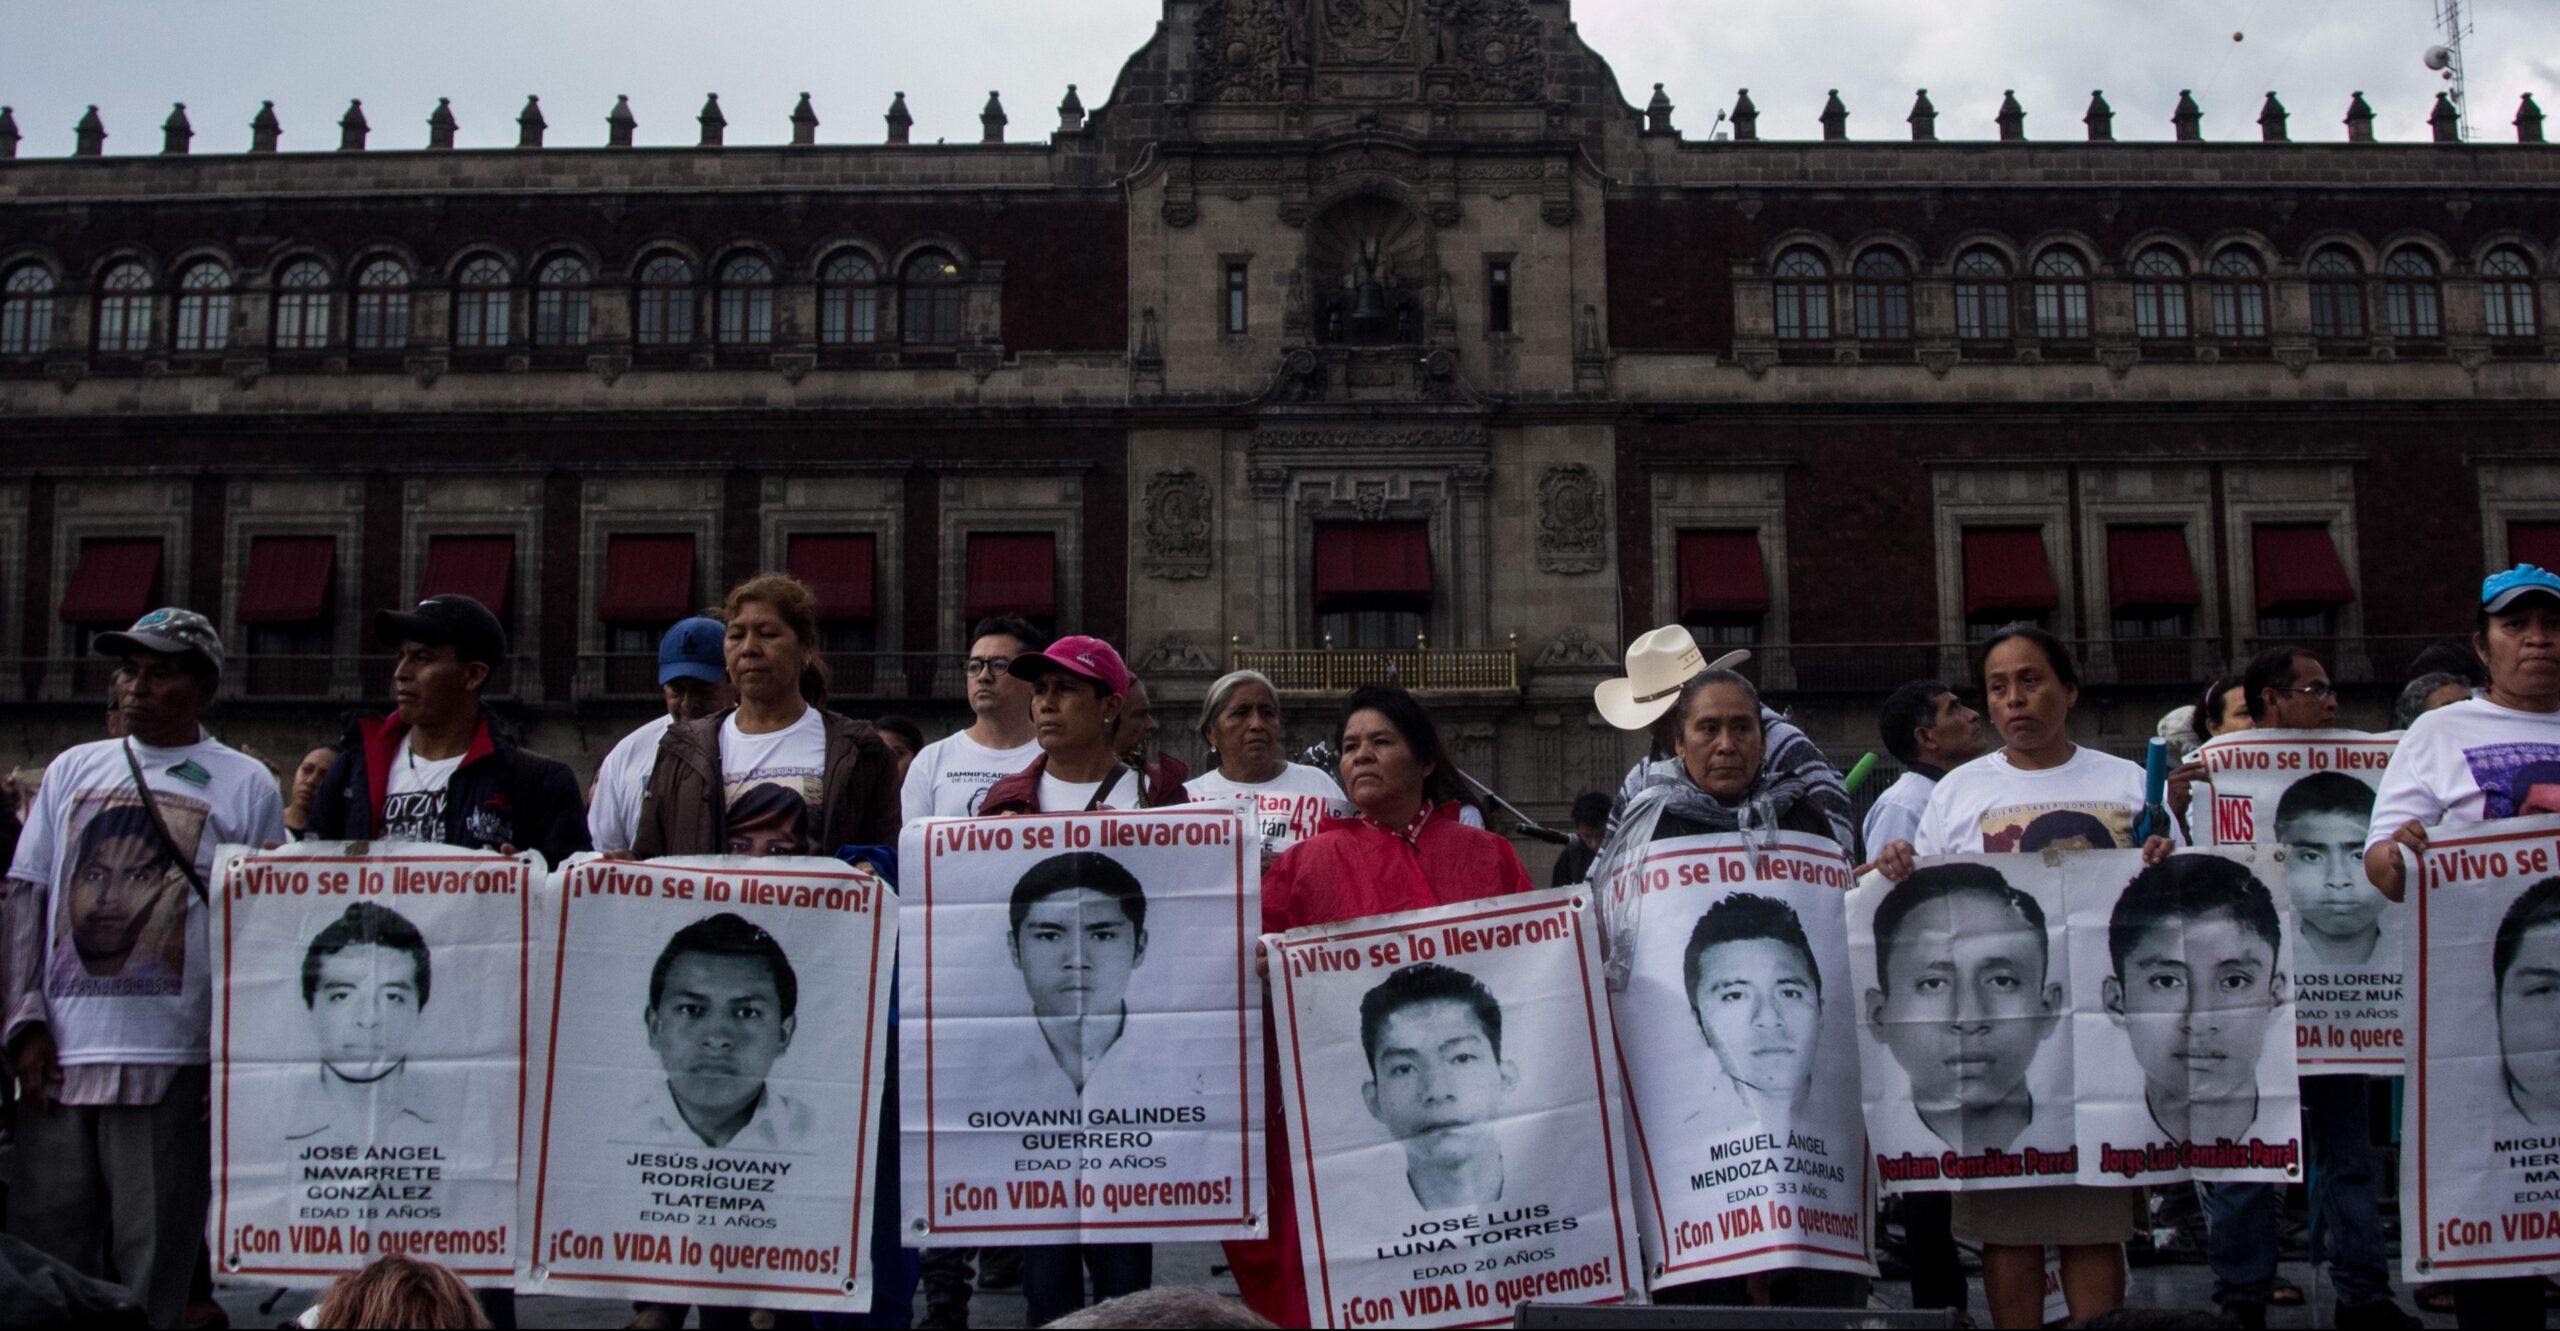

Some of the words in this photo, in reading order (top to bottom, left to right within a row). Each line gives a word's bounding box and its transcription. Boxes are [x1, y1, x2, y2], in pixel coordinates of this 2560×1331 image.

[2211, 747, 2270, 773] ¡Vivo
[2277, 753, 2300, 769] se
[2309, 747, 2328, 770] lo
[2336, 748, 2394, 770] lleva
[1261, 817, 1288, 838] tán
[2219, 799, 2254, 841] NOS
[936, 824, 1013, 857] ¡Vivo
[1023, 825, 1054, 850] se
[1064, 821, 1091, 848] lo
[1101, 819, 1231, 848] llevaron!
[234, 865, 309, 899] ¡Vivo
[317, 871, 349, 895] se
[358, 867, 384, 895] lo
[392, 866, 518, 895] llevaron!
[1678, 863, 1710, 886] se
[1718, 857, 1746, 883] lo
[2429, 849, 2508, 889] ¡Vivo
[2515, 848, 2548, 875] se
[573, 866, 653, 898] ¡Vivo
[661, 877, 695, 900] se
[703, 876, 731, 902] lo
[739, 878, 871, 913] llevaron!
[1292, 945, 1361, 978] ¡Vivo
[1370, 940, 1401, 968] se
[1408, 934, 1437, 962] lo
[1442, 911, 1569, 957] llevaron!
[2295, 988, 2361, 1001] ÁNDEZ
[2335, 1010, 2351, 1019] 19
[2356, 1007, 2399, 1019] AÑOS
[2328, 1024, 2344, 1048] lo
[2350, 1028, 2403, 1051] quere
[968, 1110, 1082, 1128] GIOVANNI
[1088, 1106, 1206, 1125] GALINDES
[300, 1146, 359, 1161] JOSÉ
[1022, 1132, 1153, 1150] GUERRERO
[1710, 1133, 1781, 1162] MIGUEL
[1787, 1130, 1828, 1156] ÁNGEL
[2494, 1136, 2560, 1153] MIGU
[304, 1167, 441, 1180] NAVARRETE
[627, 1153, 699, 1170] JESÚS
[702, 1159, 792, 1175] JOVANY
[1015, 1159, 1071, 1171] EDAD
[1079, 1158, 1102, 1169] 20
[1109, 1155, 1167, 1169] AÑOS
[1691, 1158, 1779, 1191] MENDOZA
[1784, 1157, 1845, 1183] ZACARIAS
[2101, 1142, 2147, 1178] Jorge
[2146, 1141, 2180, 1171] Luis
[307, 1185, 433, 1200] GONZÁLEZ
[641, 1173, 775, 1192] RODRÍGUEZ
[945, 1182, 998, 1216] ¡Con
[1006, 1180, 1068, 1209] VIDA
[1075, 1177, 1095, 1208] lo
[1103, 1176, 1232, 1213] queremos!
[1726, 1185, 1768, 1203] EDAD
[1776, 1183, 1797, 1194] 33
[1801, 1182, 1828, 1200] AÑOS
[300, 1208, 349, 1219] EDAD
[359, 1208, 379, 1219] 18
[385, 1205, 442, 1219] AÑOS
[651, 1192, 766, 1212] TLATEMPA
[639, 1211, 691, 1224] EDAD
[697, 1215, 717, 1226] 21
[724, 1215, 777, 1229] AÑOS
[1402, 1214, 1480, 1238] JOSÉ
[1488, 1203, 1551, 1226] LUIS
[1674, 1221, 1714, 1256] ¡Con
[1717, 1204, 1764, 1240] VIDA
[1769, 1201, 1792, 1230] lo
[1797, 1204, 1859, 1241] queremos!
[2438, 1217, 2492, 1252] ¡Con
[2501, 1210, 2560, 1242] VIDA
[234, 1224, 281, 1258] ¡Con
[289, 1225, 343, 1254] VIDA
[351, 1225, 370, 1254] lo
[378, 1226, 506, 1255] queremos!
[550, 1229, 604, 1263] ¡Con
[613, 1232, 672, 1264] VIDA
[680, 1236, 702, 1266] lo
[709, 1243, 840, 1274] queremos!
[1377, 1237, 1457, 1260] LUNA
[1464, 1217, 1579, 1247] TORRES
[1413, 1262, 1467, 1281] EDAD
[1475, 1258, 1497, 1272] 20
[1503, 1248, 1556, 1267] AÑOS
[1342, 1296, 1394, 1328] ¡Con
[1400, 1283, 1462, 1317] VIDA
[1466, 1279, 1489, 1308] lo
[1495, 1256, 1612, 1308] queremos!
